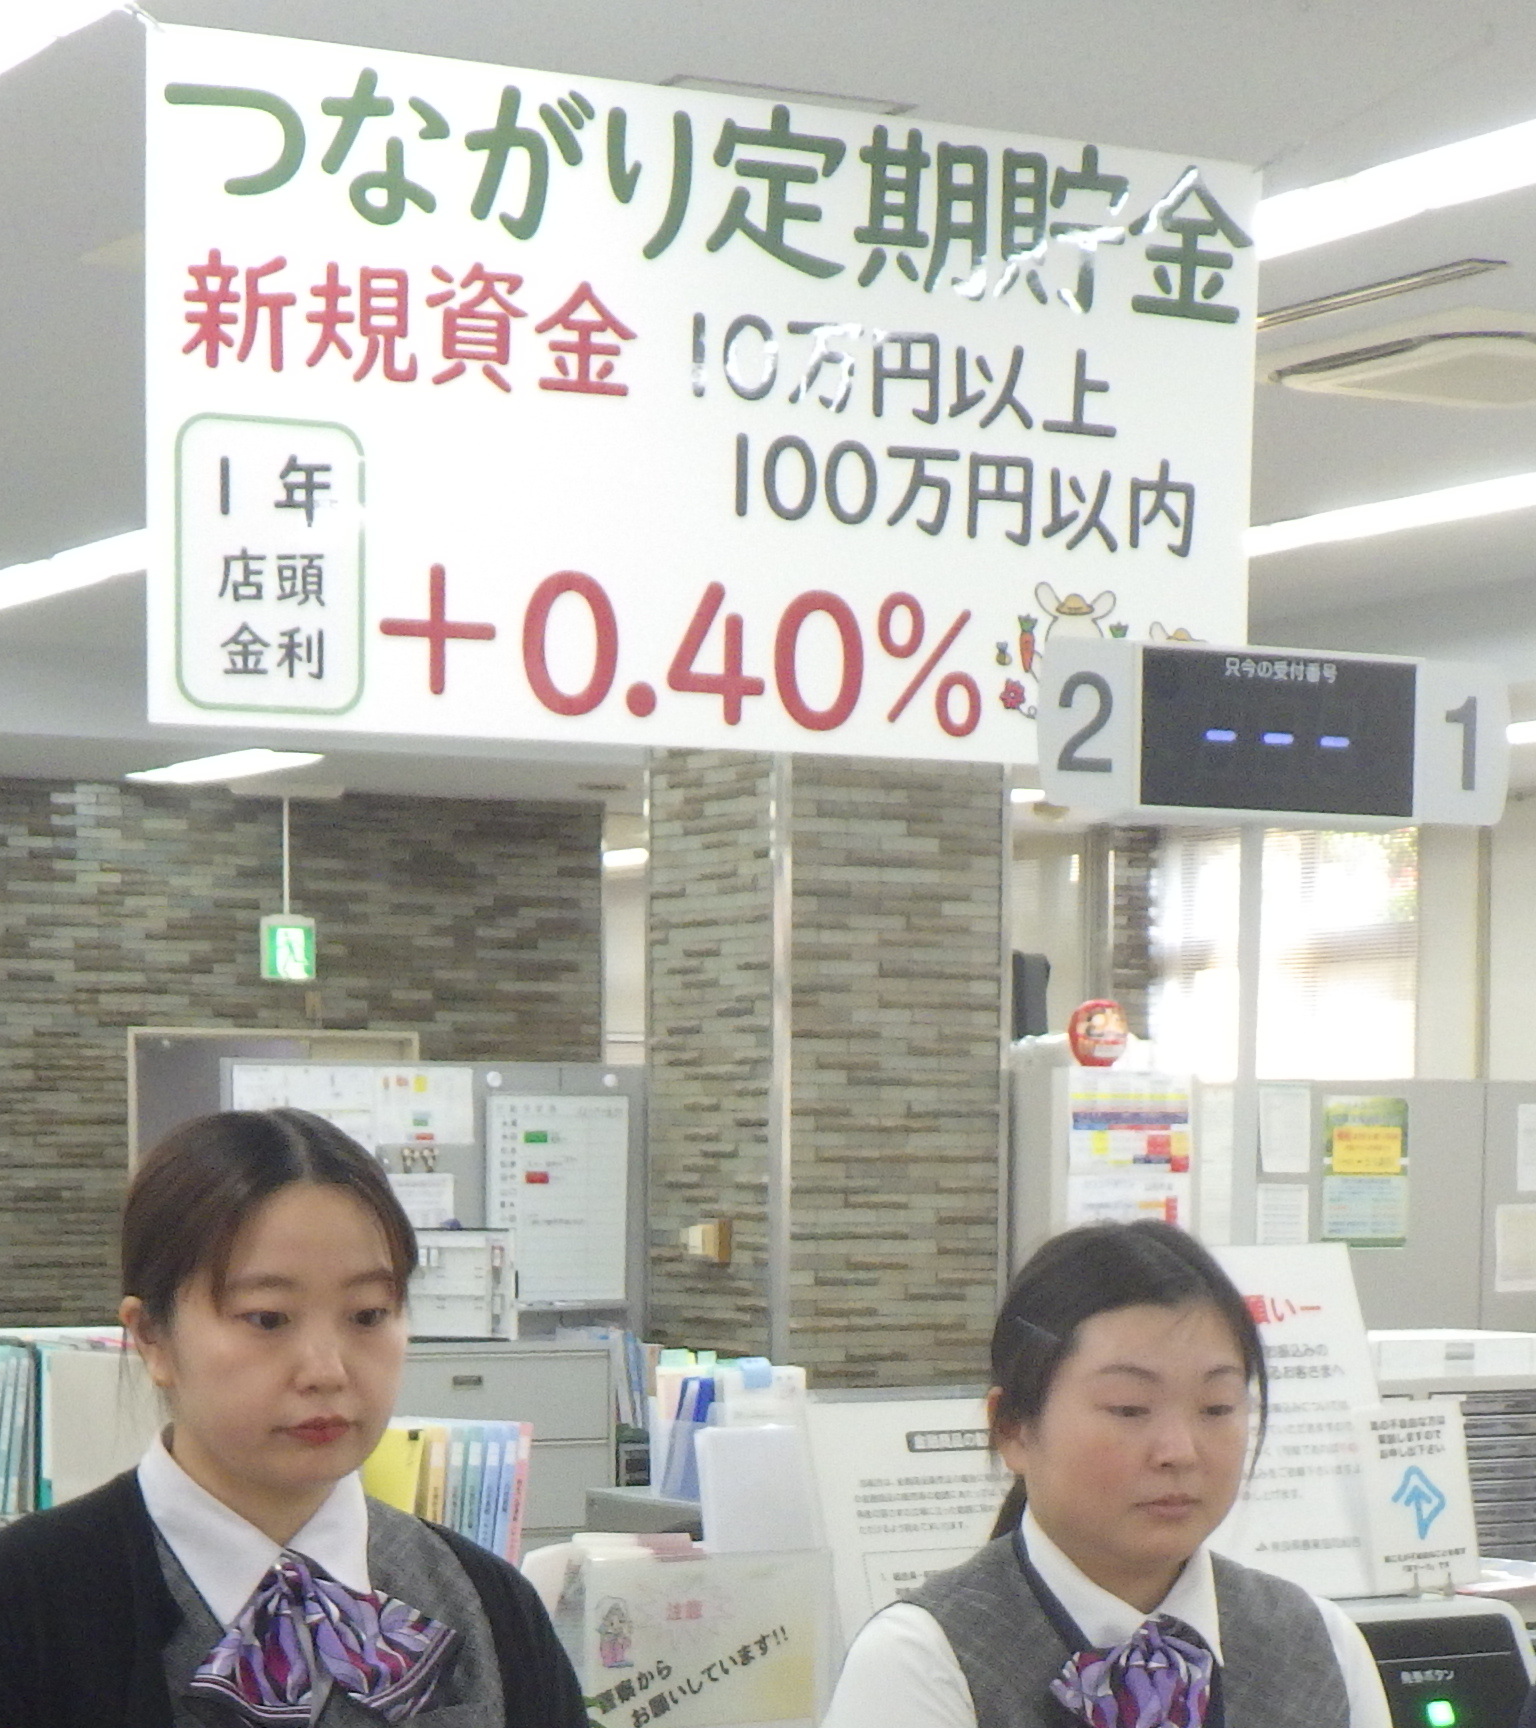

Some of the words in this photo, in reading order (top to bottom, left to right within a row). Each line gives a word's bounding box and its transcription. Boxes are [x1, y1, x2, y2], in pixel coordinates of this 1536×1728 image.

[163, 66, 1253, 325] つながり定期貯金
[182, 249, 637, 399] 新規資金
[690, 310, 1118, 439] 10万円以上
[735, 431, 1197, 559] 100万円以内
[216, 551, 328, 608] 店頭
[220, 625, 328, 681] 金利
[379, 562, 982, 738] +0.40%
[1225, 656, 1338, 684] 只今の受付番号
[1057, 671, 1114, 773] 2
[1444, 695, 1478, 791] 1
